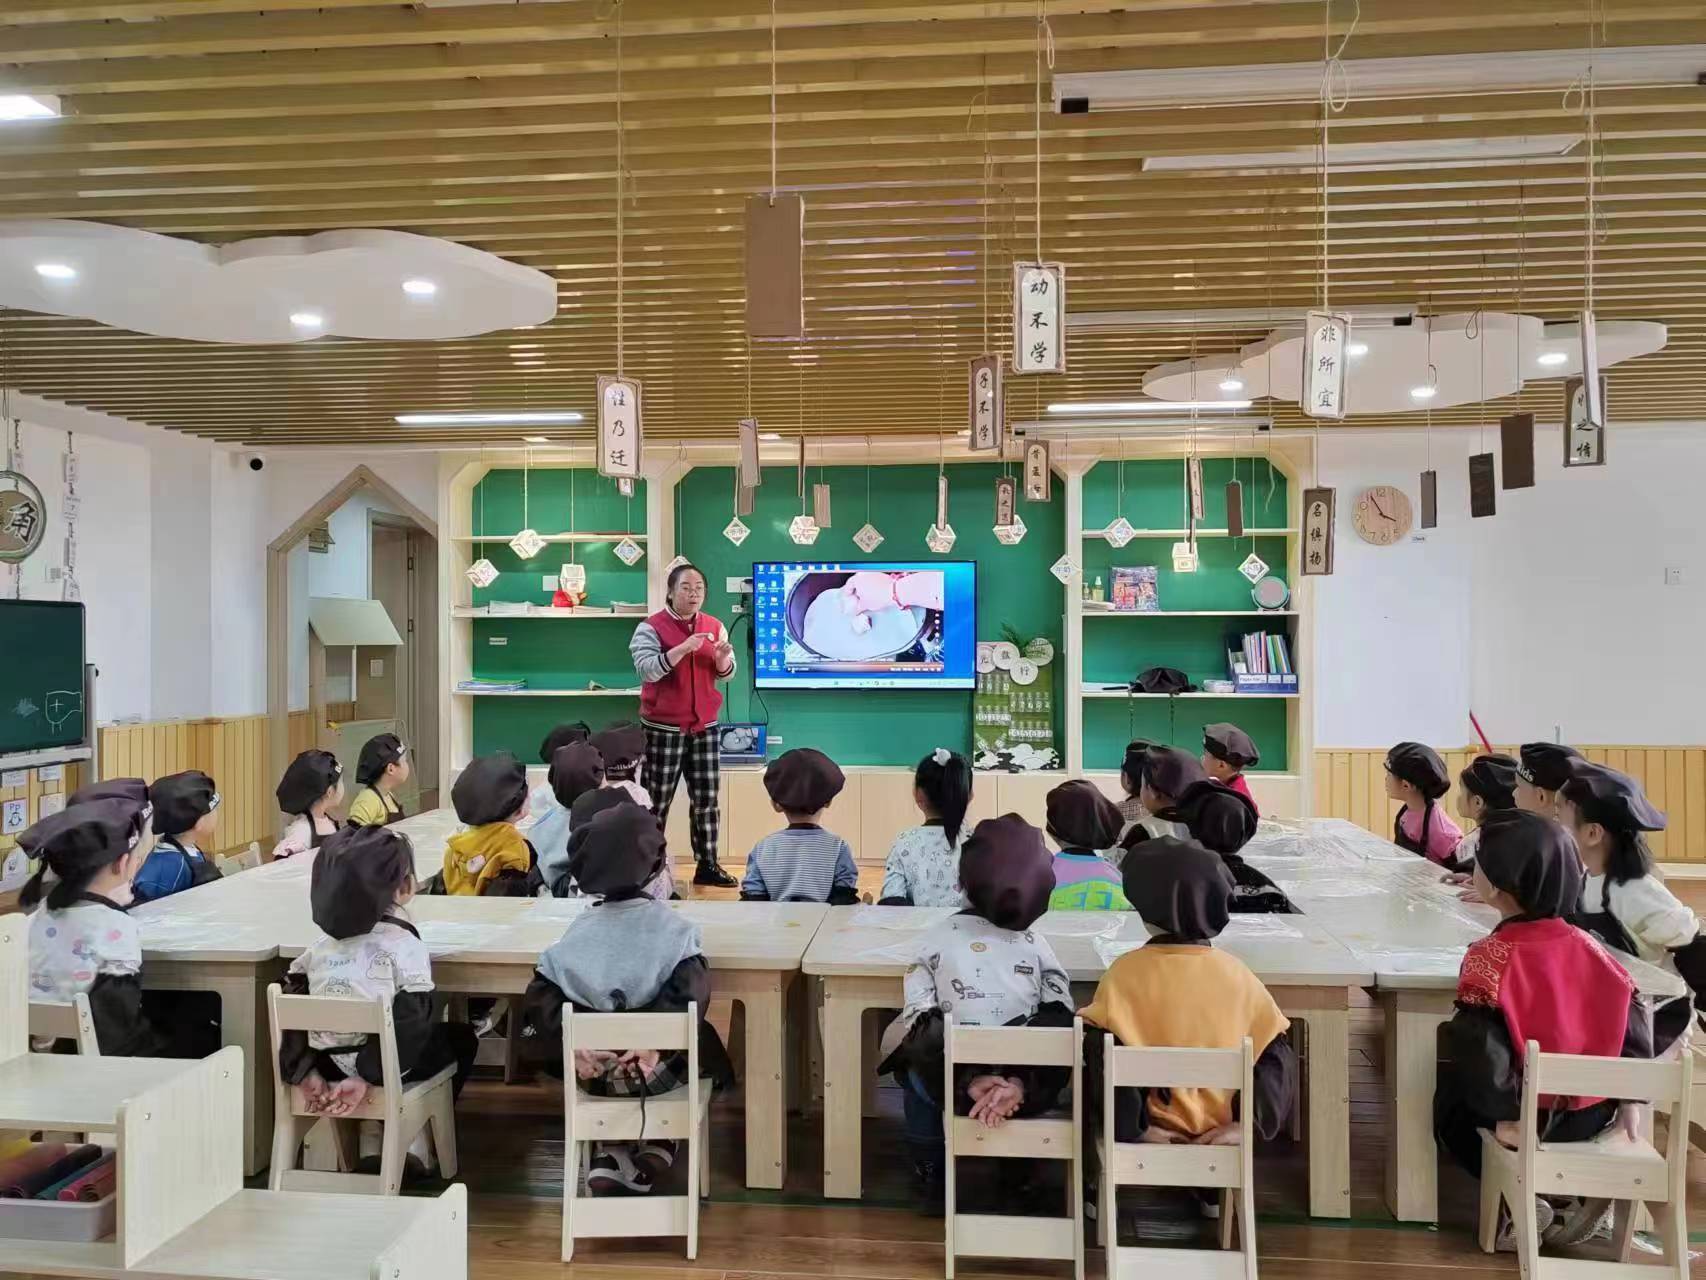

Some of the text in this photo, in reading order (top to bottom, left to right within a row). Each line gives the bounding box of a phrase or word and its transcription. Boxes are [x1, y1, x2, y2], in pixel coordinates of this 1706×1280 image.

[1317, 325, 1337, 408] 非所宜
[0, 500, 37, 544] 角
